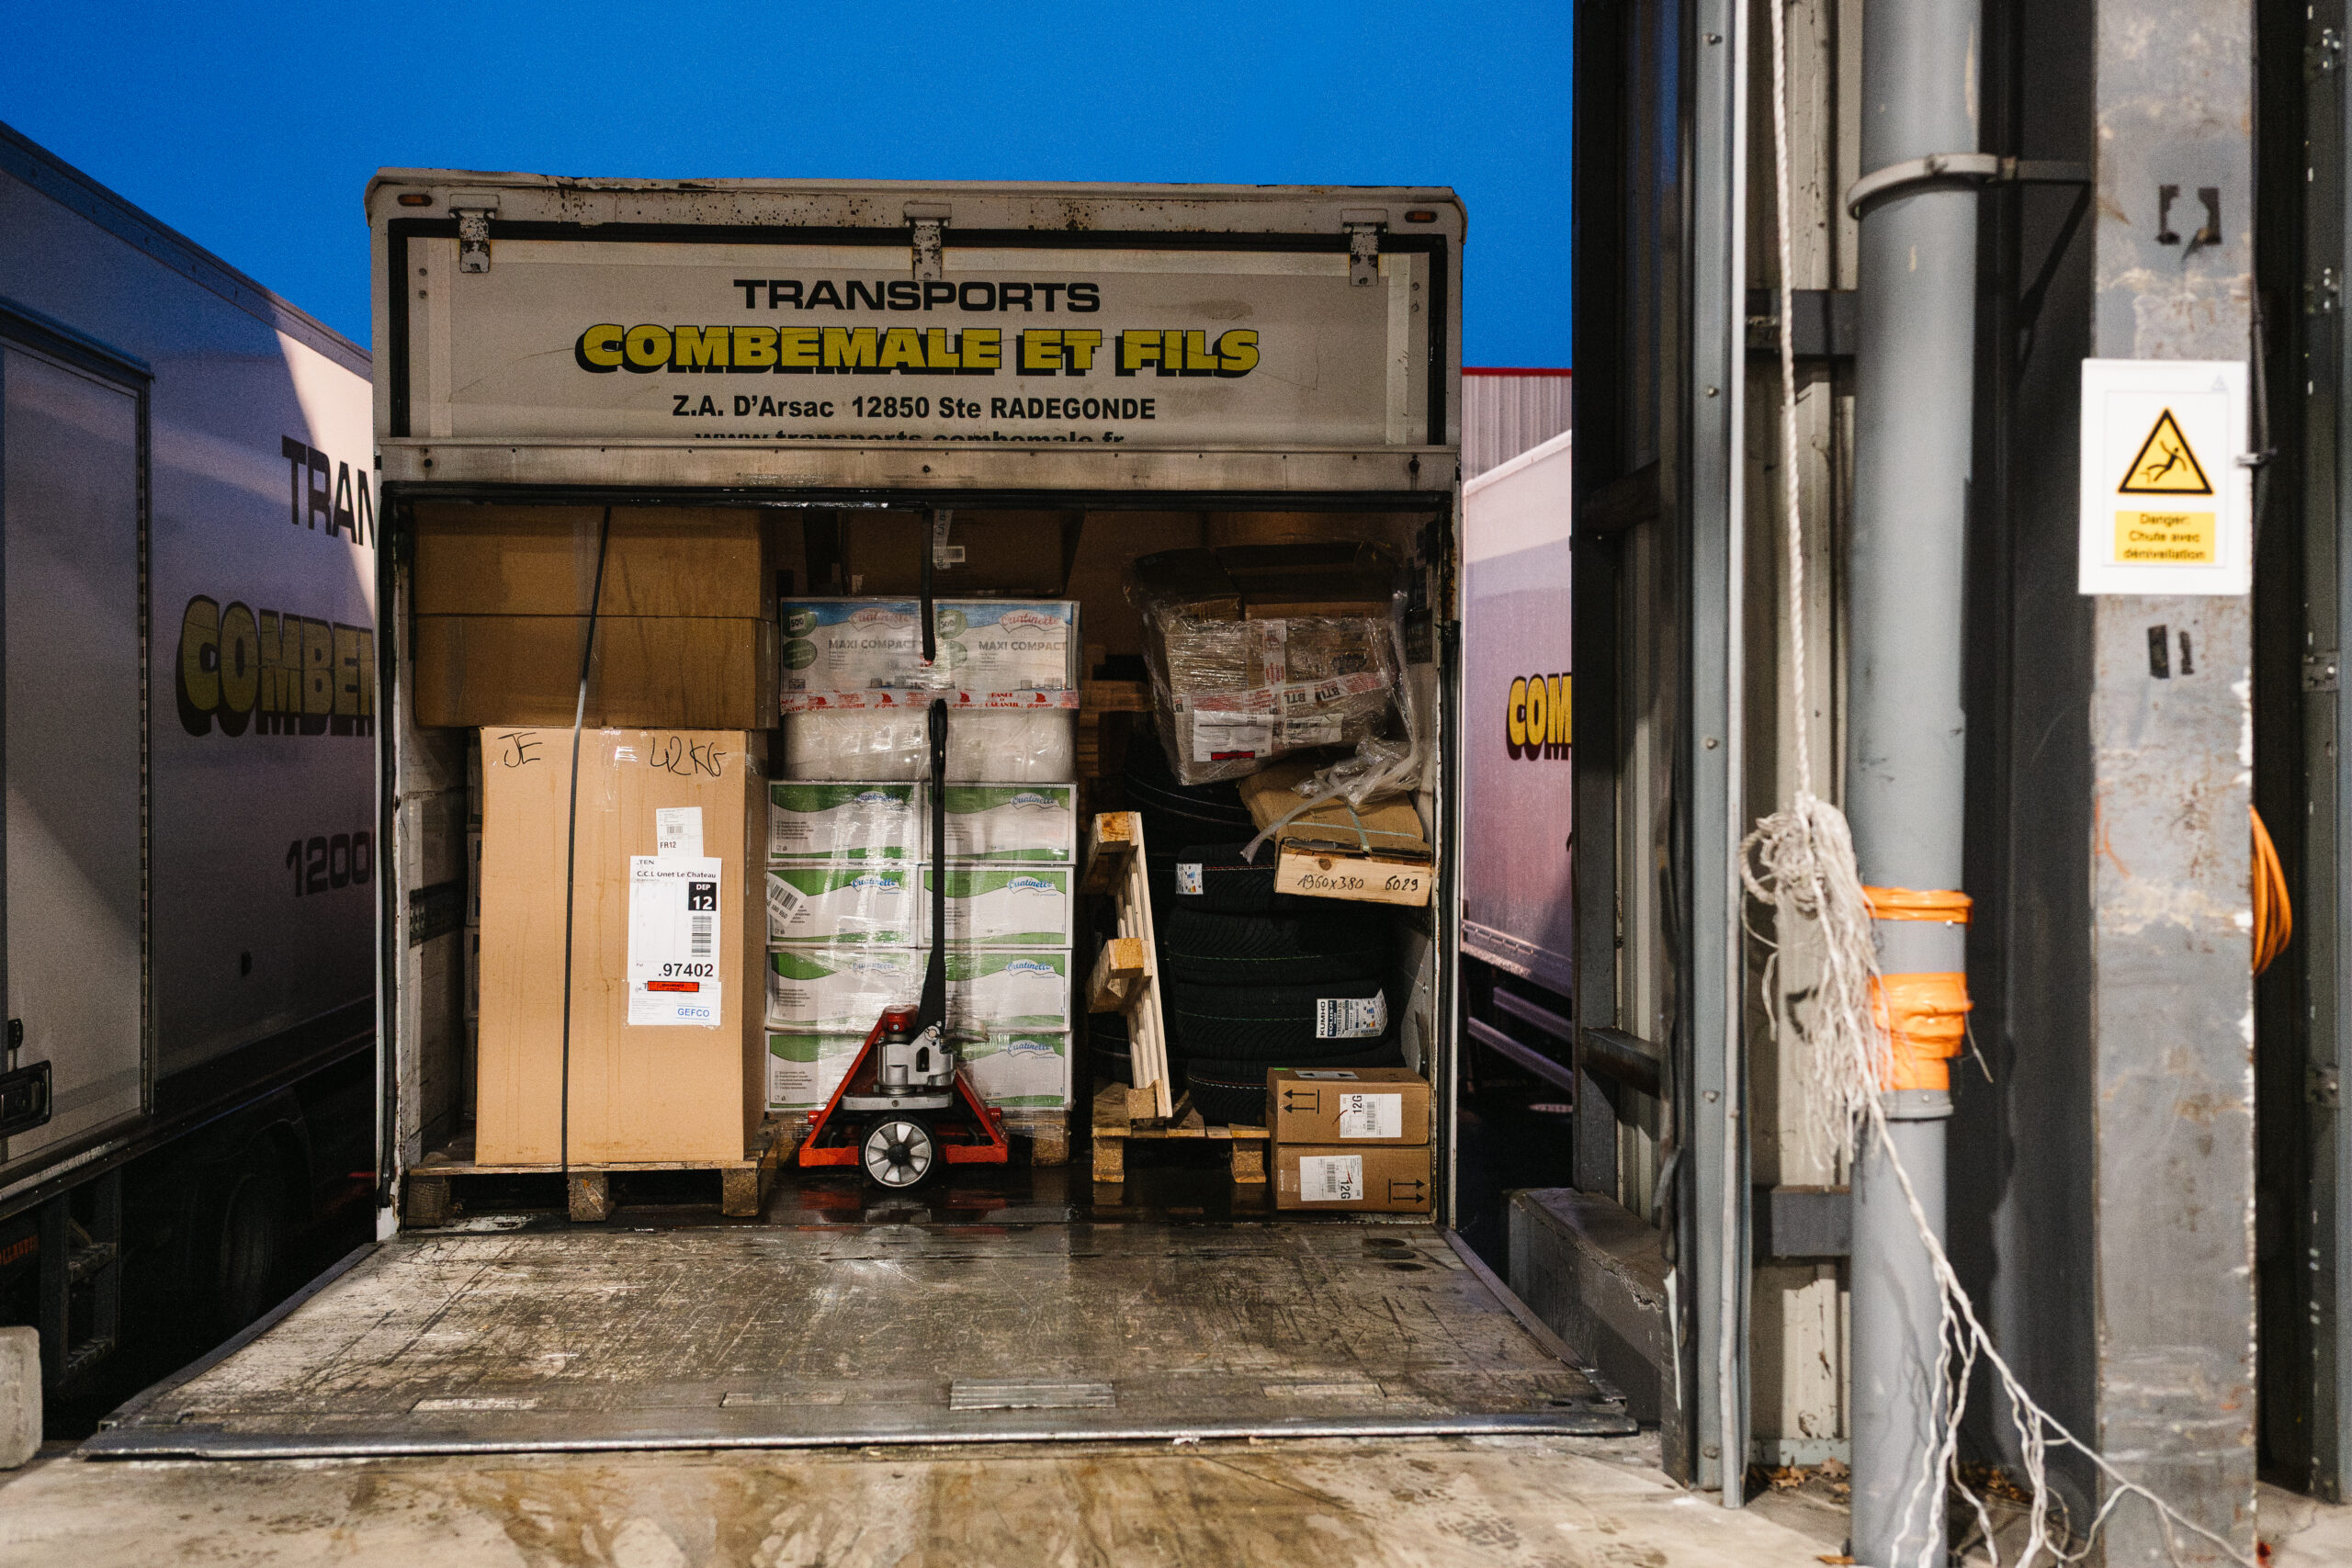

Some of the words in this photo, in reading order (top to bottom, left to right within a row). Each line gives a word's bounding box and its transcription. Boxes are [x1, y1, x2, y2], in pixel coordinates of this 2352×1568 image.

[734, 279, 1100, 312] TRANSPORTS
[574, 323, 1001, 376] COMBEMALE
[1016, 328, 1102, 377] ET
[1115, 328, 1260, 378] FILS
[673, 395, 724, 417] Z.A.
[734, 395, 834, 418] D'Arsac
[853, 396, 930, 418] 12850
[939, 397, 981, 419] Ste
[990, 397, 1156, 420] RADEGONDE
[2129, 530, 2165, 542] Chute
[2171, 534, 2201, 543] avec
[829, 639, 857, 649] MAXI
[978, 641, 1007, 650] MAXI
[1011, 641, 1066, 651] COMPACT
[286, 830, 376, 897] 1200
[693, 895, 713, 910] 12
[677, 1008, 710, 1018] GEFCO
[1351, 1095, 1363, 1114] 12G
[1340, 1179, 1351, 1200] 12G
